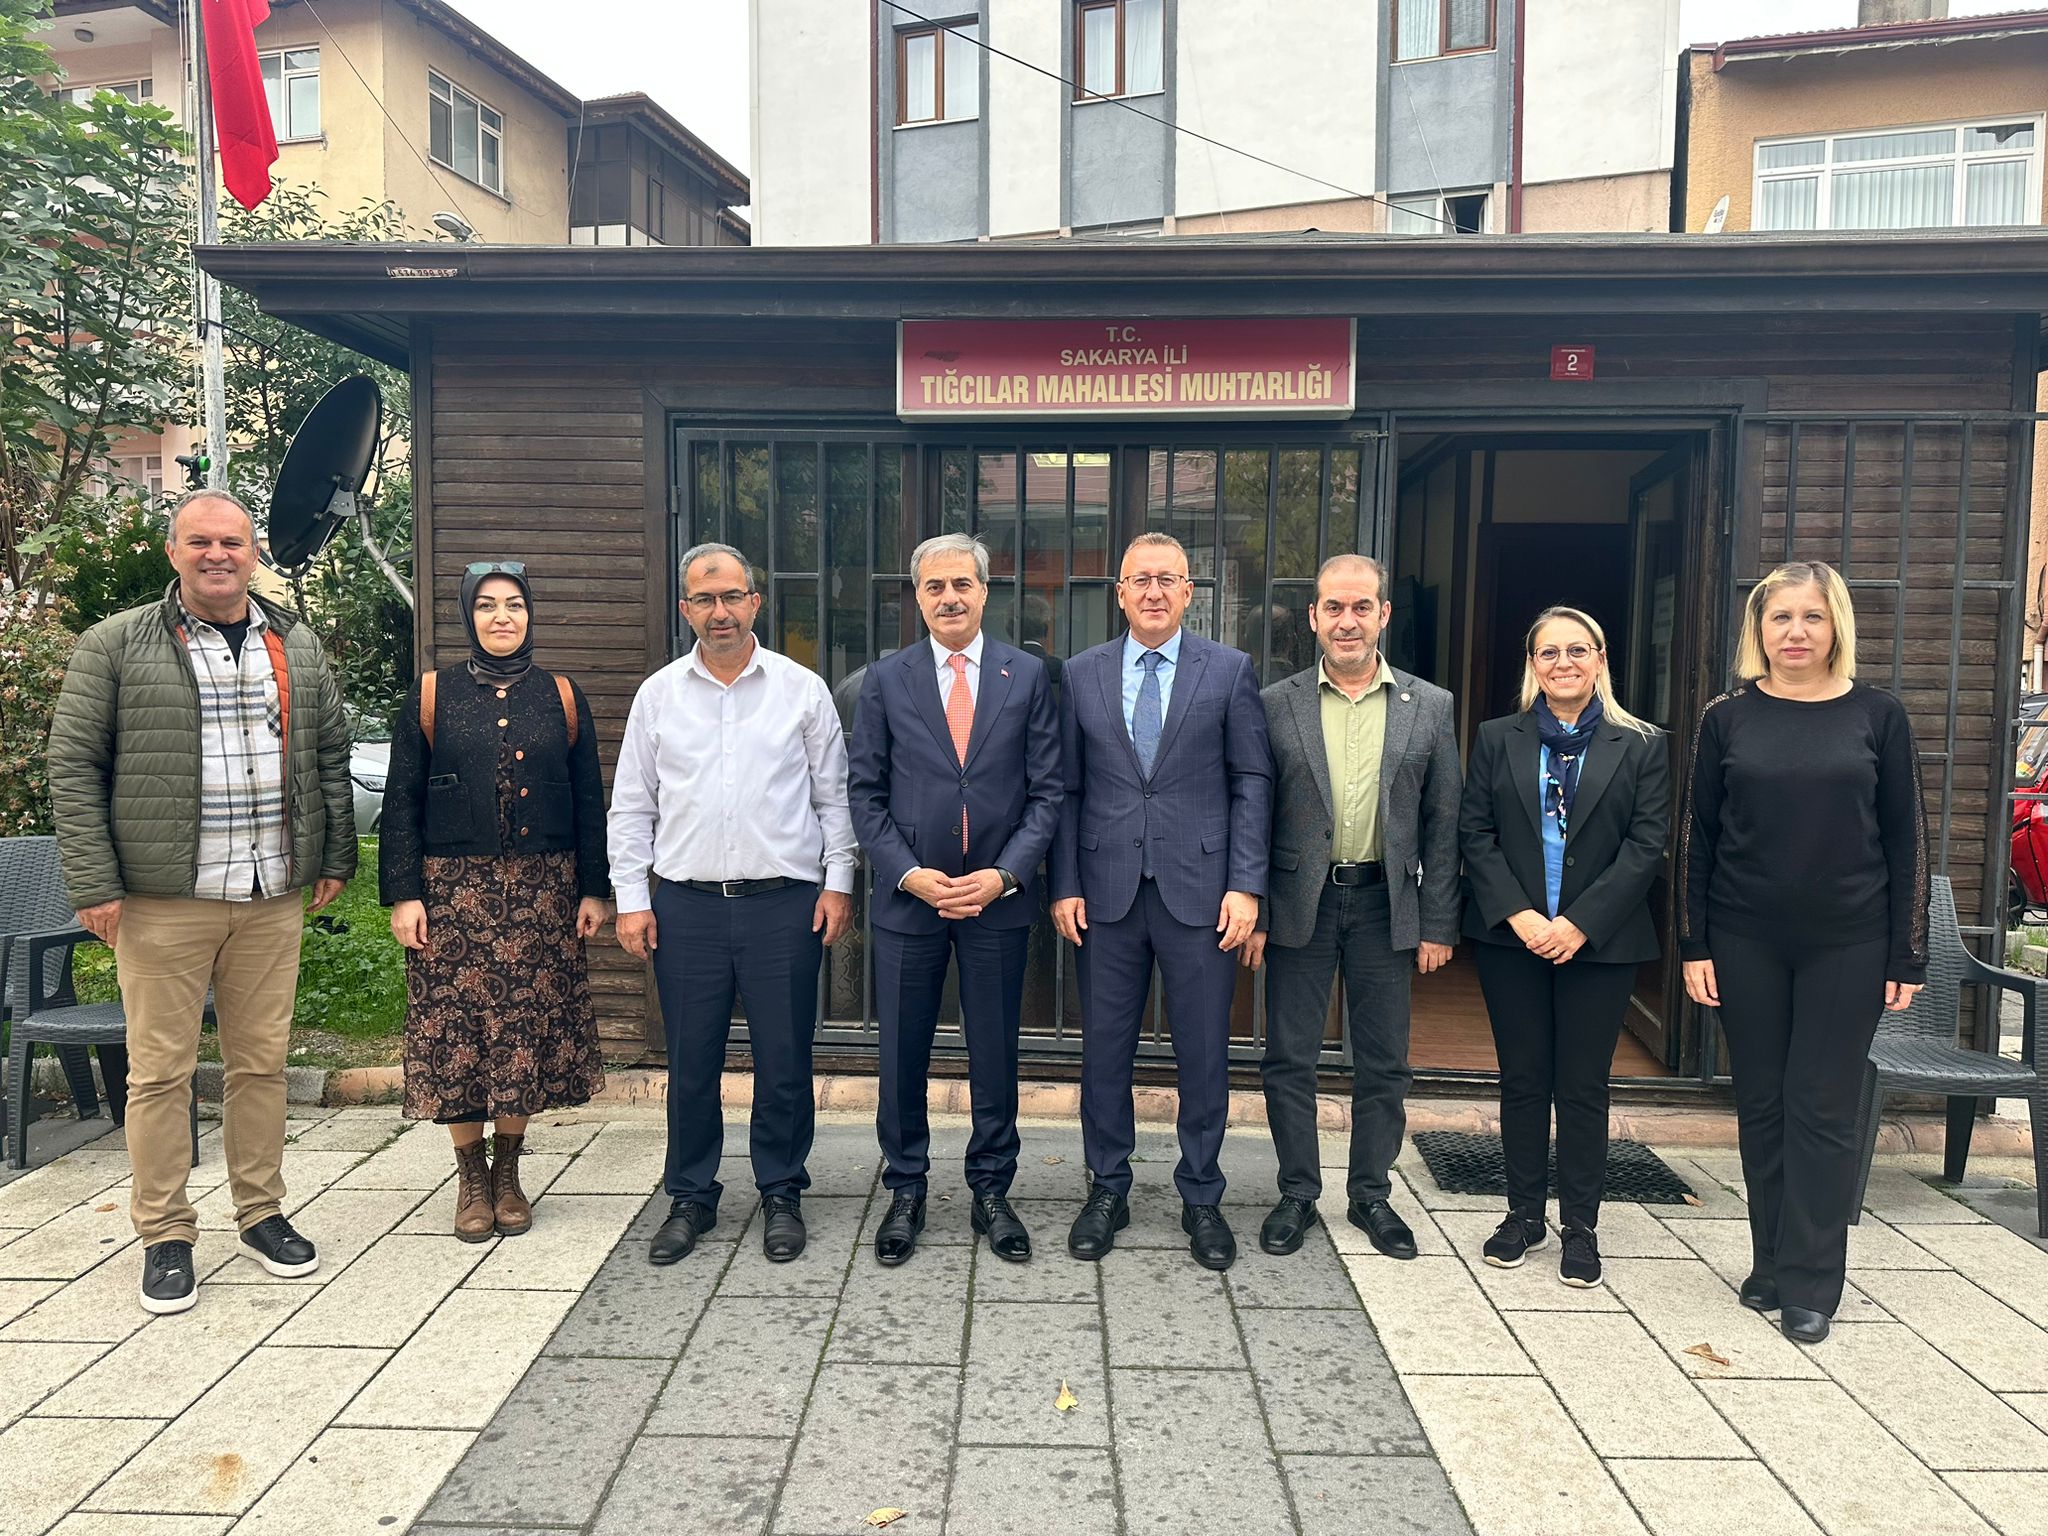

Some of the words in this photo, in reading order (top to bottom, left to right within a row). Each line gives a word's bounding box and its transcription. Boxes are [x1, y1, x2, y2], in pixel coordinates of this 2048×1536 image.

[1105, 326, 1142, 343] T.C.
[1060, 348, 1159, 366] SAKARYA
[1163, 344, 1188, 365] İLİ
[1567, 354, 1578, 371] 2
[920, 368, 1029, 404] TIĞCILAR
[1036, 366, 1173, 404] MAHALLESİ
[1180, 363, 1332, 402] MUHTARLIĞI
